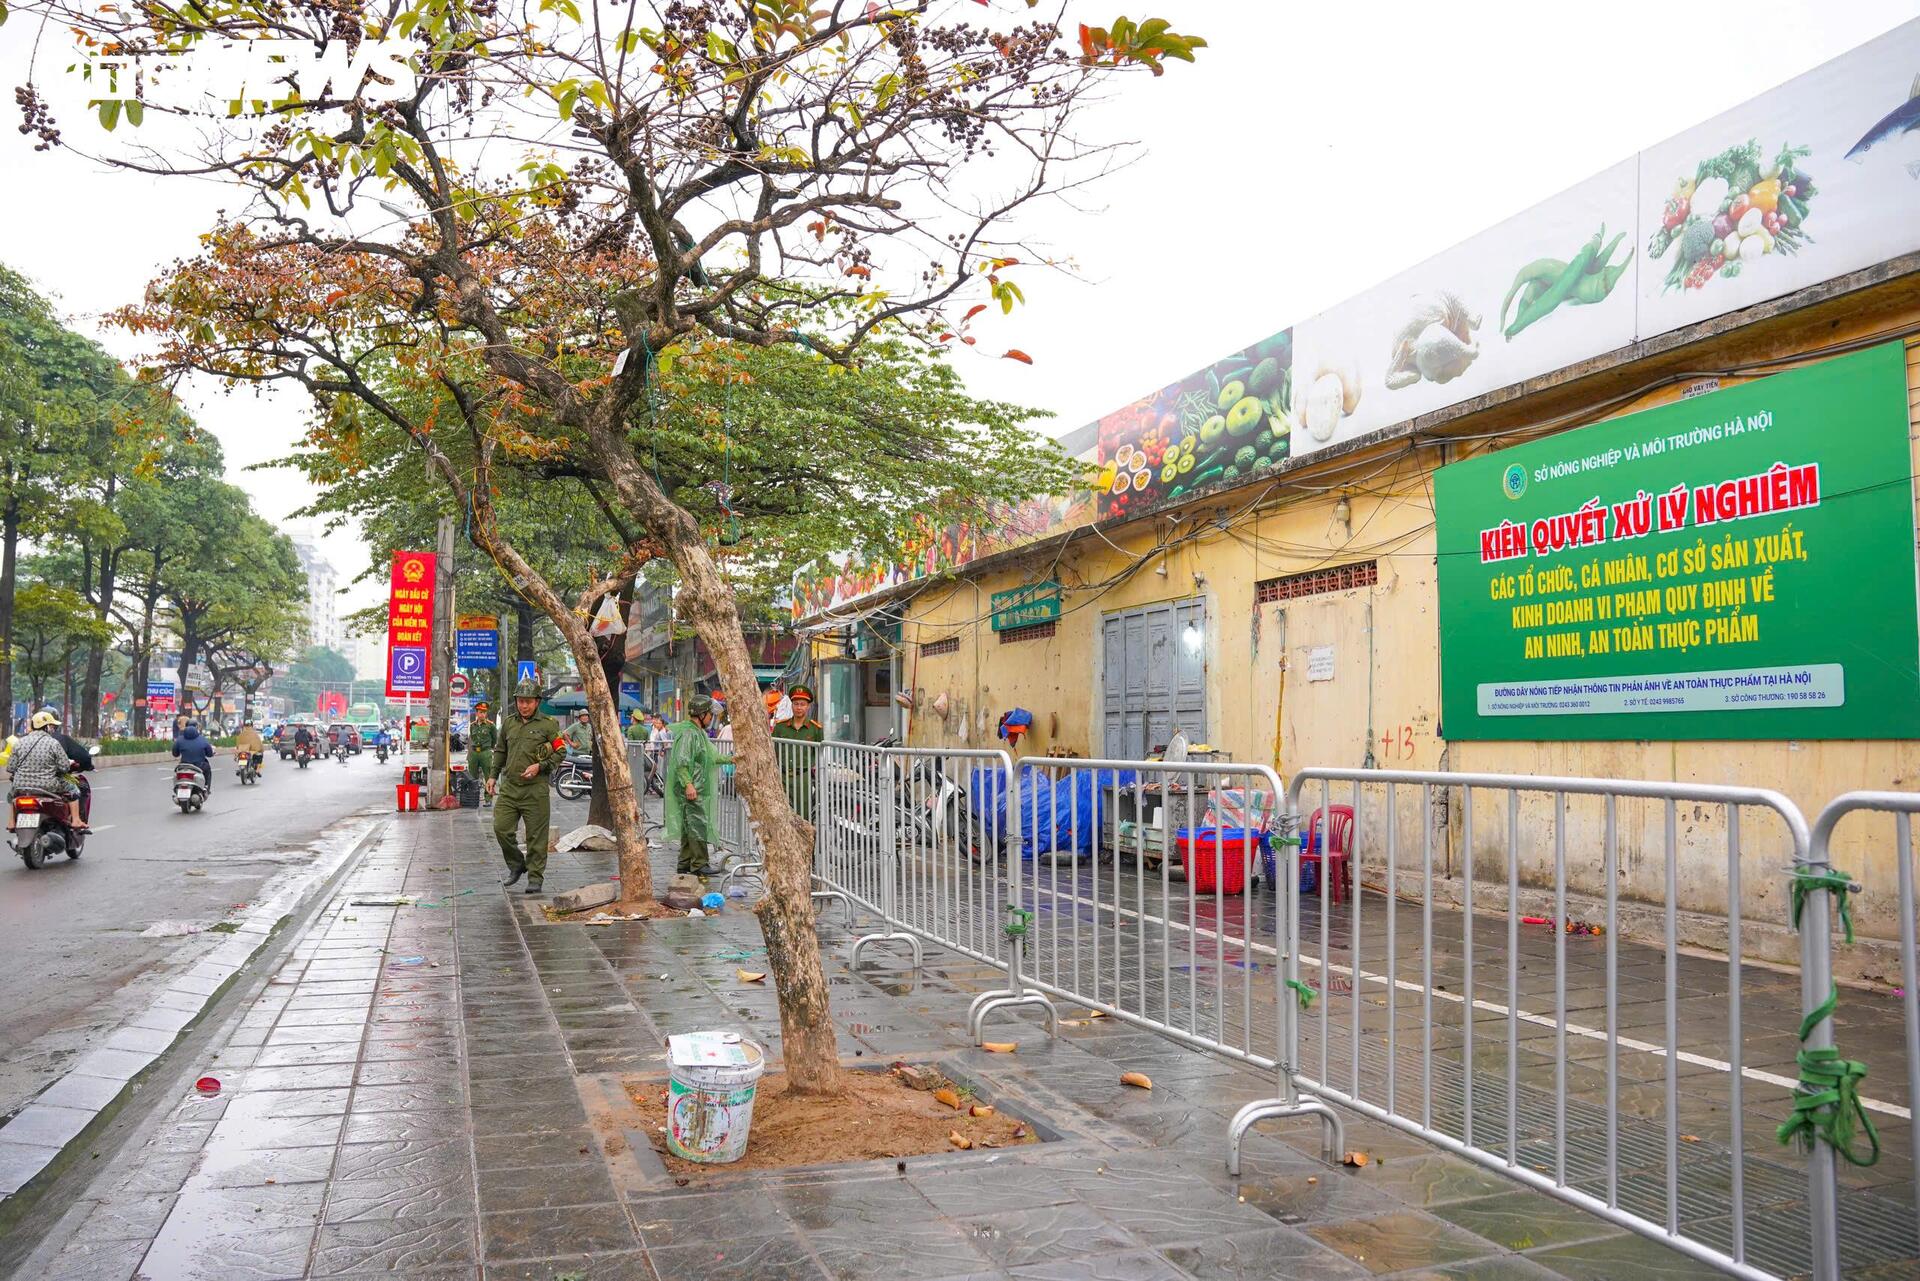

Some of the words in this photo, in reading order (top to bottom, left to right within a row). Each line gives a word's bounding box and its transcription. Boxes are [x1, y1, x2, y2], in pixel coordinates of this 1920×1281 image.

[1534, 464, 1549, 482] SỞ
[1550, 461, 1580, 480] NÔNG
[1581, 448, 1622, 468] NGHIỆP
[1623, 443, 1641, 461] VÀ
[1642, 437, 1666, 457] MÔI
[1667, 425, 1722, 450] TRƯỜNG
[1724, 416, 1745, 437] HÀ
[1747, 410, 1773, 432] NỘI
[1481, 519, 1527, 563] KIÊN
[1532, 496, 1608, 557] QUYẾT
[1613, 490, 1653, 538] XỬ
[1658, 482, 1689, 533] LÝ
[1694, 462, 1820, 527] NGHIÊM
[1490, 573, 1515, 600] CÁC
[1518, 564, 1534, 597] TỔ
[1537, 564, 1578, 594] CHỨC,
[1581, 558, 1601, 588] CÁ
[1604, 553, 1652, 585] NHÂN,
[1656, 548, 1679, 578] CƠ
[1683, 538, 1706, 574] SỞ
[1711, 533, 1749, 570] SẢN
[1753, 522, 1808, 564] XUẤT,
[1512, 604, 1543, 629] KINH
[1546, 598, 1593, 626] DOANH
[1597, 595, 1612, 620] VI
[1615, 589, 1661, 621] PHẠM
[1665, 584, 1697, 615] QUY
[1702, 578, 1746, 613] ĐỊNH
[1751, 565, 1775, 603] VỀ
[1524, 636, 1543, 659] AN
[1546, 632, 1585, 658] NINH,
[1589, 630, 1609, 654] AN
[1613, 621, 1653, 652] TOÀN
[1657, 618, 1700, 652] THỰC
[1705, 605, 1759, 645] PHẨM
[404, 656, 415, 670] P
[1494, 687, 1516, 697] ĐƯỜNG
[1516, 686, 1529, 697] DÂY
[1529, 685, 1548, 696] NÓNG
[1548, 684, 1562, 695] TIẾP
[1563, 683, 1583, 696] NHẬN
[1584, 682, 1608, 694] THÔNG
[1608, 683, 1621, 693] TIN
[1622, 680, 1643, 692] PHẢN
[1643, 679, 1661, 691] ÁNH
[1661, 678, 1672, 690] VỀ
[1673, 680, 1685, 690] AN
[1685, 677, 1708, 689] TOÀN
[1709, 677, 1734, 690] THỰC
[1735, 674, 1762, 687] PHẨM
[1763, 675, 1778, 687] TẠI
[1779, 672, 1793, 684] HÀ
[1795, 671, 1812, 685] NỘI
[1731, 694, 1740, 702] SỞ
[1740, 694, 1757, 702] CÔNG
[1787, 692, 1799, 700] 190
[1799, 692, 1808, 700] 58
[1808, 691, 1817, 699] 58
[1817, 691, 1826, 699] 26
